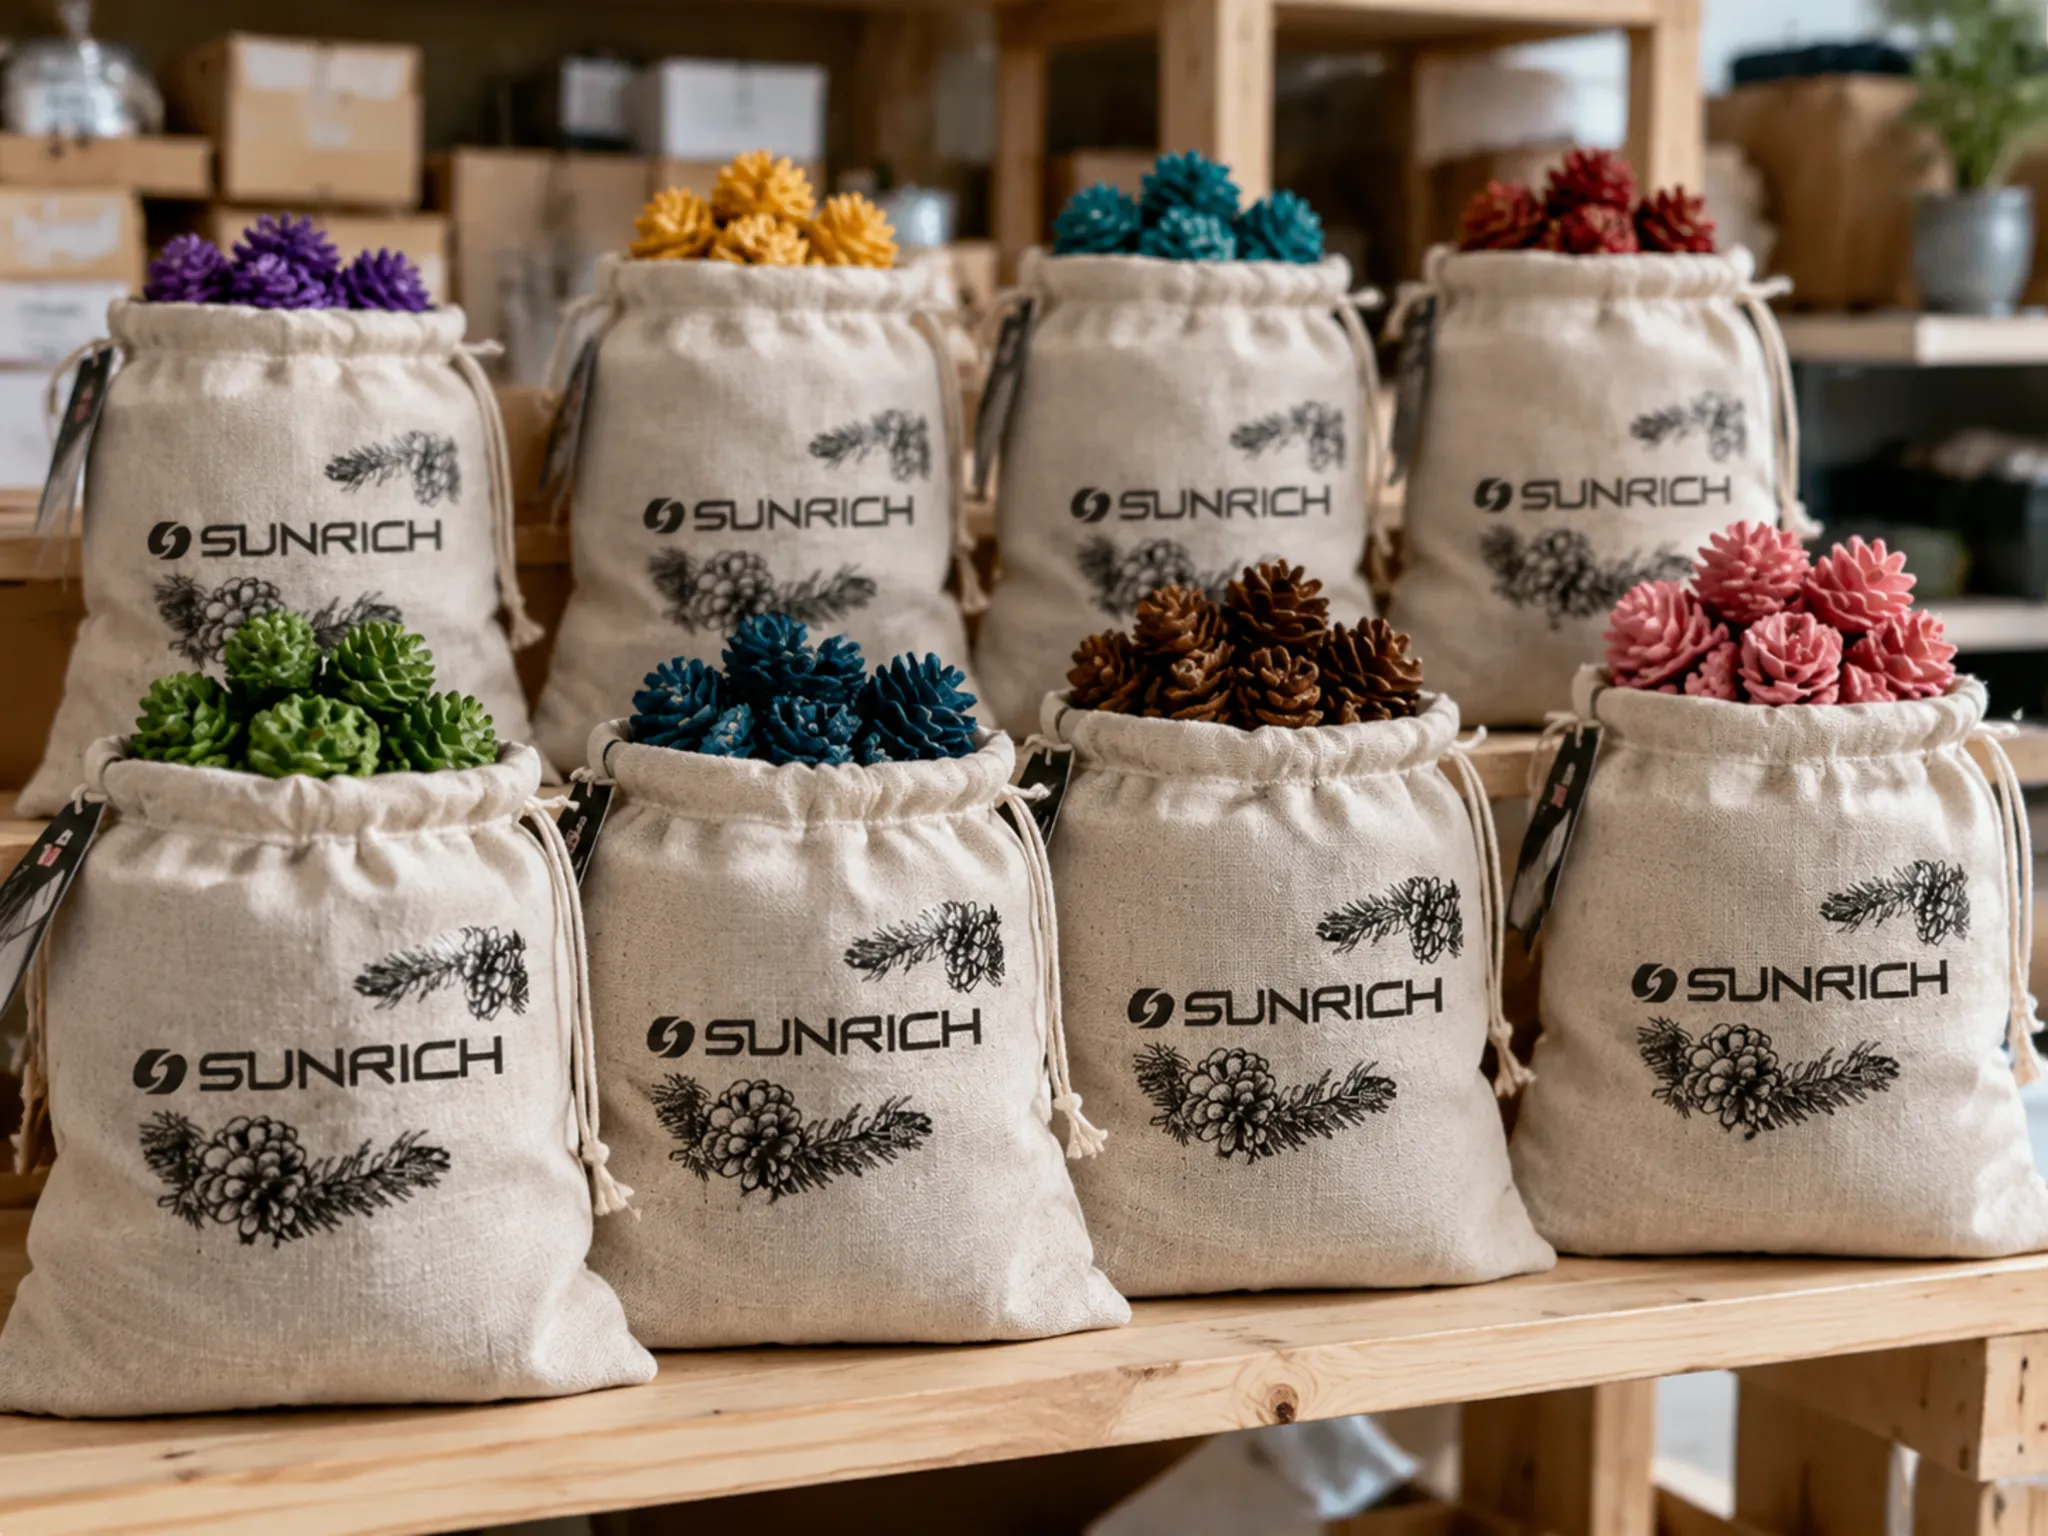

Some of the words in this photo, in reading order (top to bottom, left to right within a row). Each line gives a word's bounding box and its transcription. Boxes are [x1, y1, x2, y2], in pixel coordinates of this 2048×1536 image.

[1118, 487, 1331, 522] SUNRICH
[1520, 476, 1731, 511] SUNRICH
[692, 497, 914, 533] SUNRICH
[199, 520, 442, 559] SUNRICH
[1687, 959, 1949, 1003] SUNRICH
[1184, 977, 1443, 1027] SUNRICH
[704, 1008, 981, 1057] SUNRICH
[198, 1036, 503, 1092] SUNRICH
